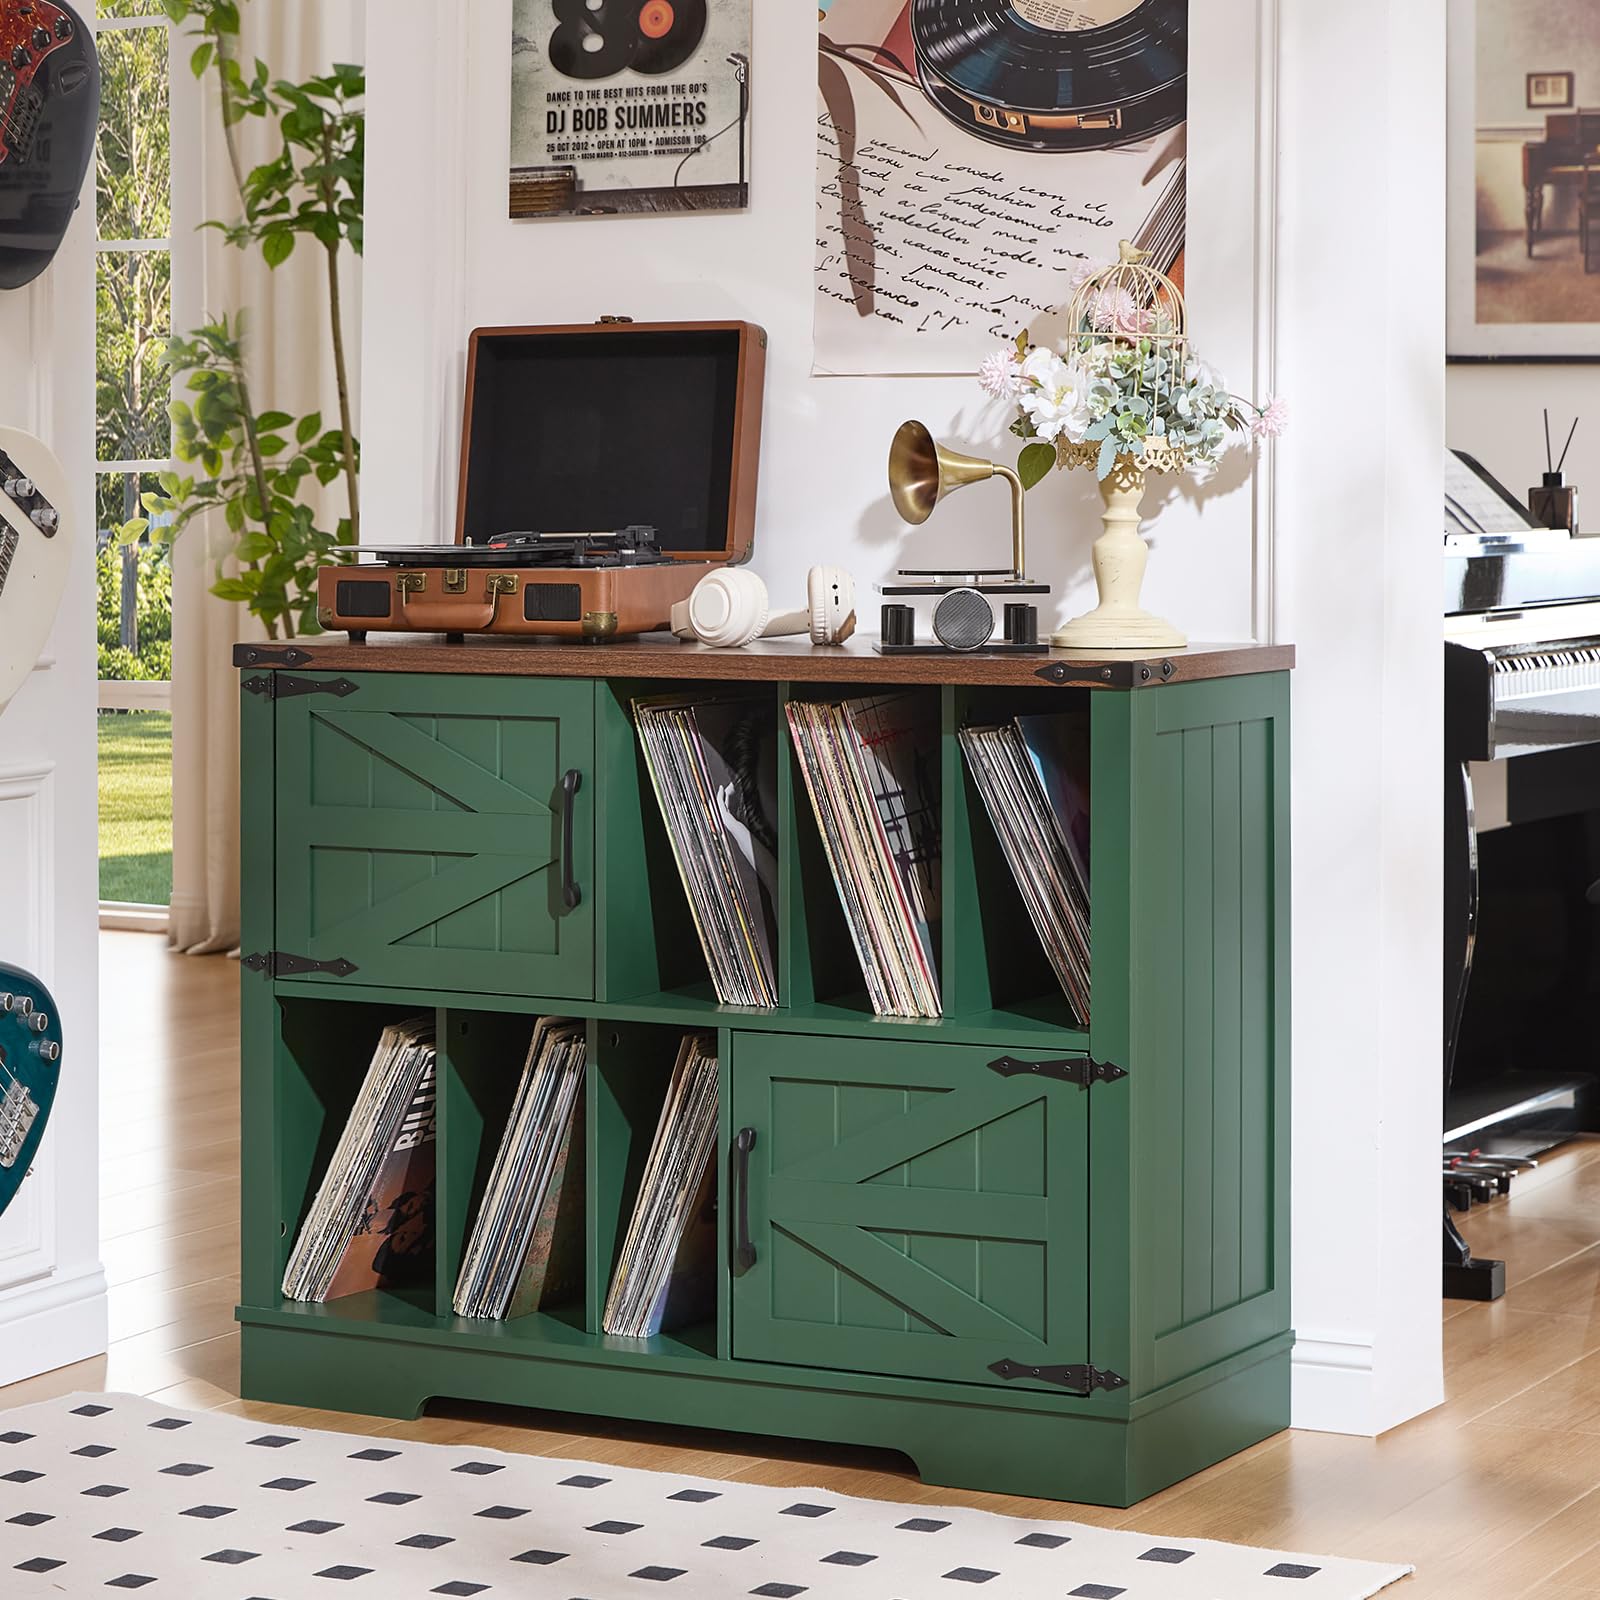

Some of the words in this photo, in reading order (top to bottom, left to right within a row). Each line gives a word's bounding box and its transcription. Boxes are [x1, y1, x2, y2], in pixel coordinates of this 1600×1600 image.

[546, 91, 571, 103] DANCE
[574, 90, 584, 101] TO
[586, 89, 601, 100] THE
[603, 88, 623, 99] BEST
[625, 87, 644, 98] HITS
[646, 85, 668, 96] FROM
[671, 84, 686, 95] THE
[688, 82, 708, 94] 80'S
[546, 110, 565, 134] DJ
[572, 107, 608, 132] BOB
[615, 101, 706, 130] SUMMERS
[546, 143, 556, 153] 25
[557, 142, 570, 152] OCT
[571, 141, 589, 151] 2012
[597, 140, 615, 150] OPEN
[616, 139, 625, 149] AT
[628, 138, 646, 148] 10PM
[655, 136, 691, 146] ADMISSON
